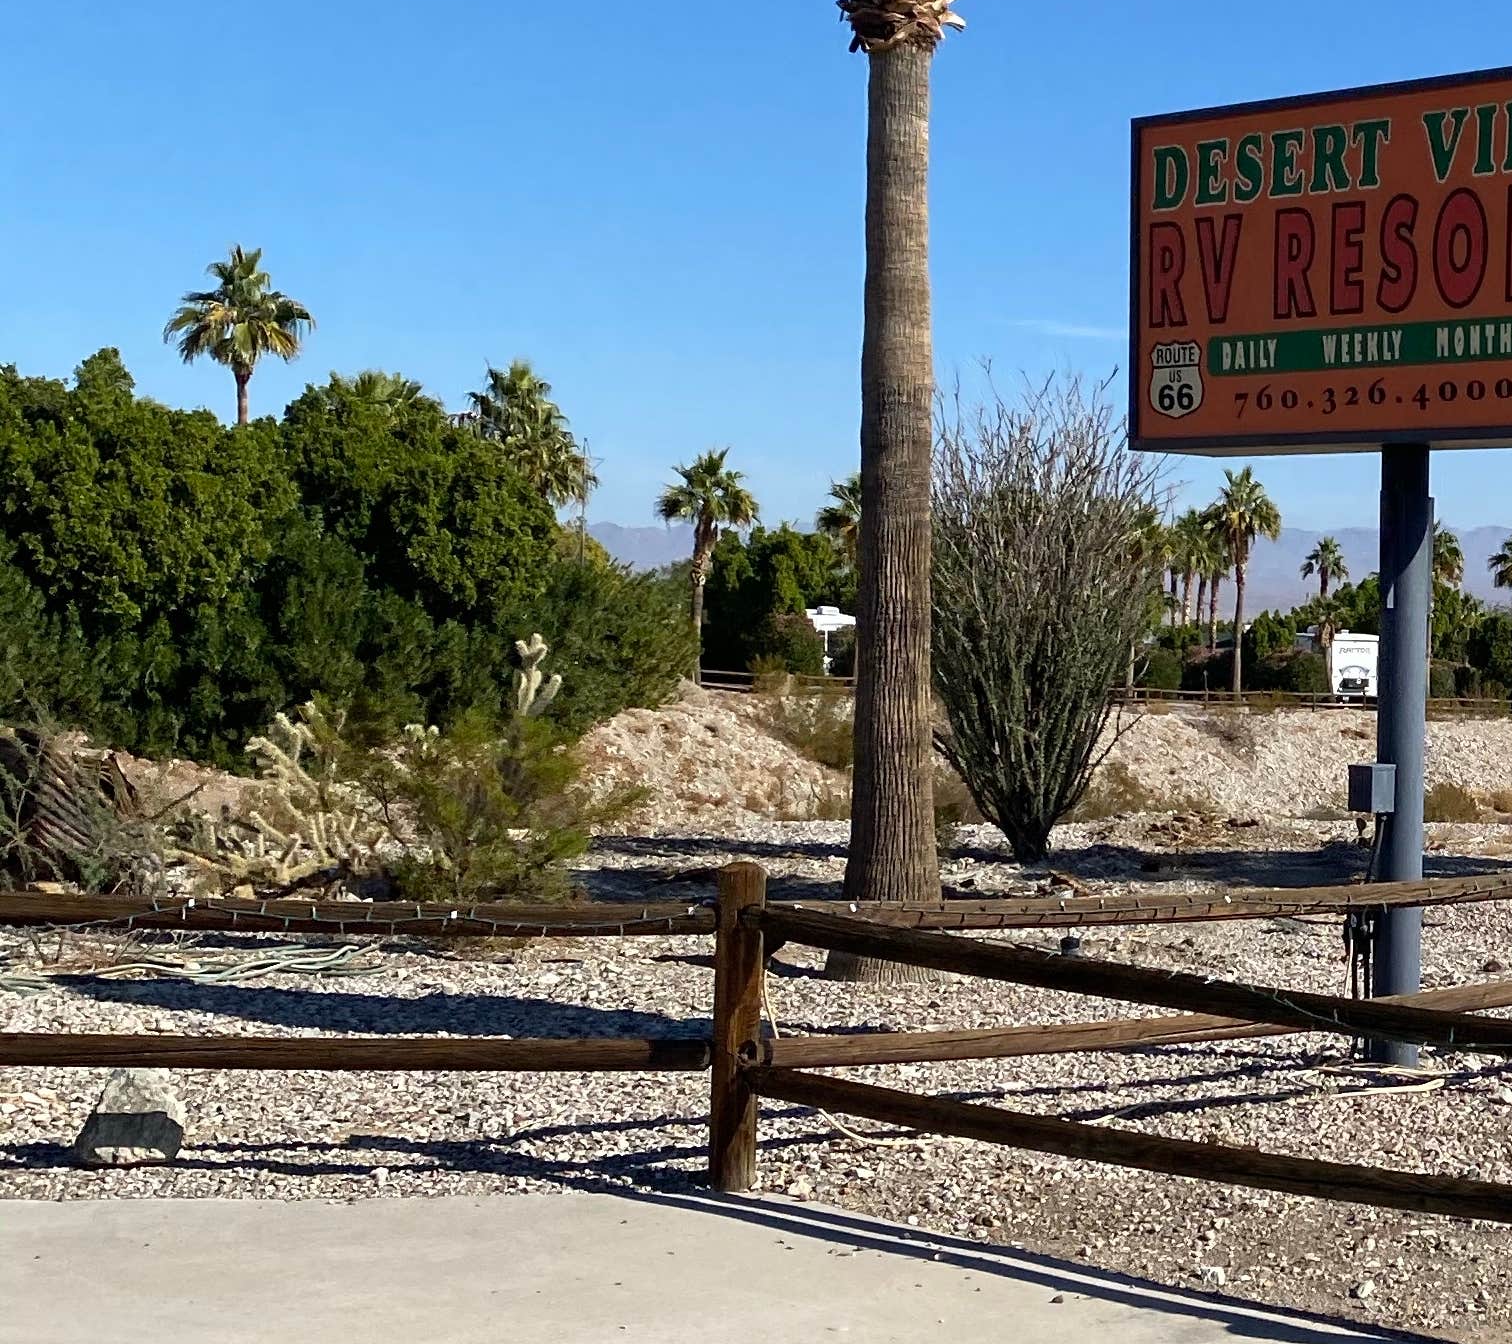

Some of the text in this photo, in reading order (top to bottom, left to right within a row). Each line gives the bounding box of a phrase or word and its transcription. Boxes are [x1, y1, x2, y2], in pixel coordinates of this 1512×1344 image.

[1152, 119, 1391, 211] DESERT
[1149, 213, 1243, 328] RV
[1156, 346, 1195, 364] ROUTE
[1222, 338, 1278, 370] DAILY
[1322, 329, 1402, 364] WEEKLY
[1169, 370, 1182, 383] US
[1158, 383, 1194, 411] 66
